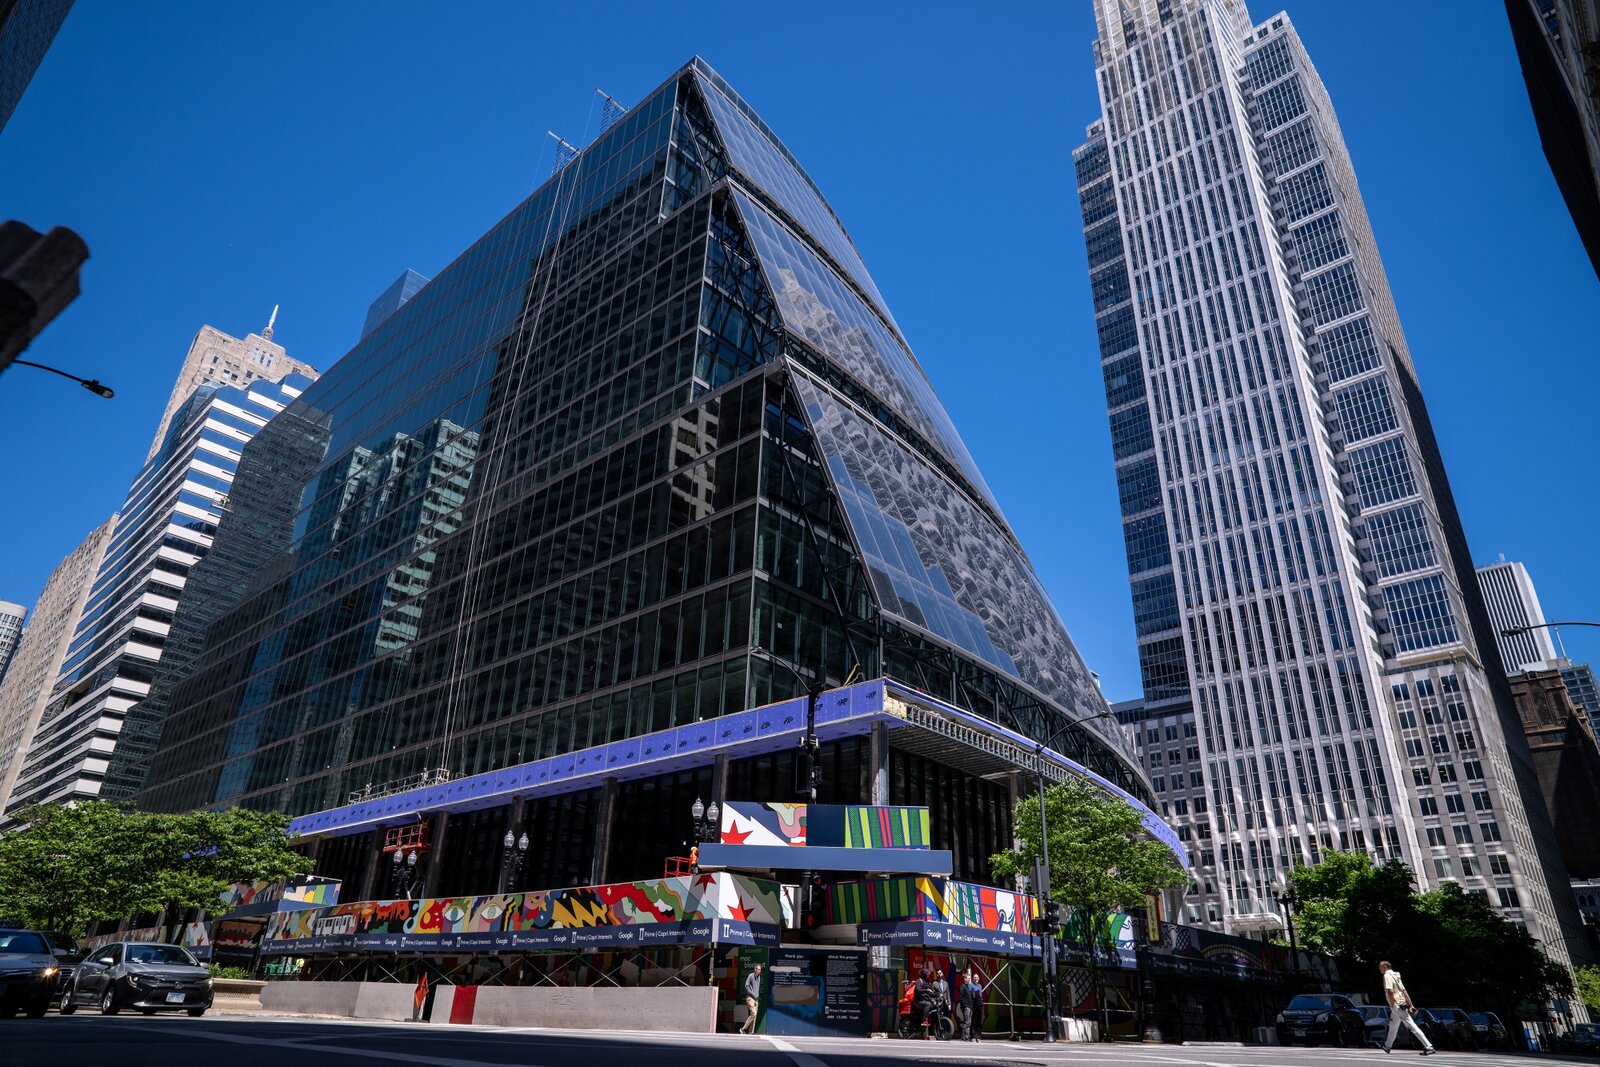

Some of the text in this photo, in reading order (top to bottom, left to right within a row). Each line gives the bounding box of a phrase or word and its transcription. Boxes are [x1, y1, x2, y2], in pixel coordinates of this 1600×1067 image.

[618, 932, 633, 940] Google
[658, 930, 668, 938] Capri
[669, 929, 686, 937] Interests
[693, 928, 710, 936] Google
[746, 930, 758, 938] Capri
[758, 932, 776, 940] Interests
[885, 932, 897, 940] Capri
[927, 929, 942, 939] Google
[554, 935, 566, 943] Google
[992, 938, 1006, 946] Google
